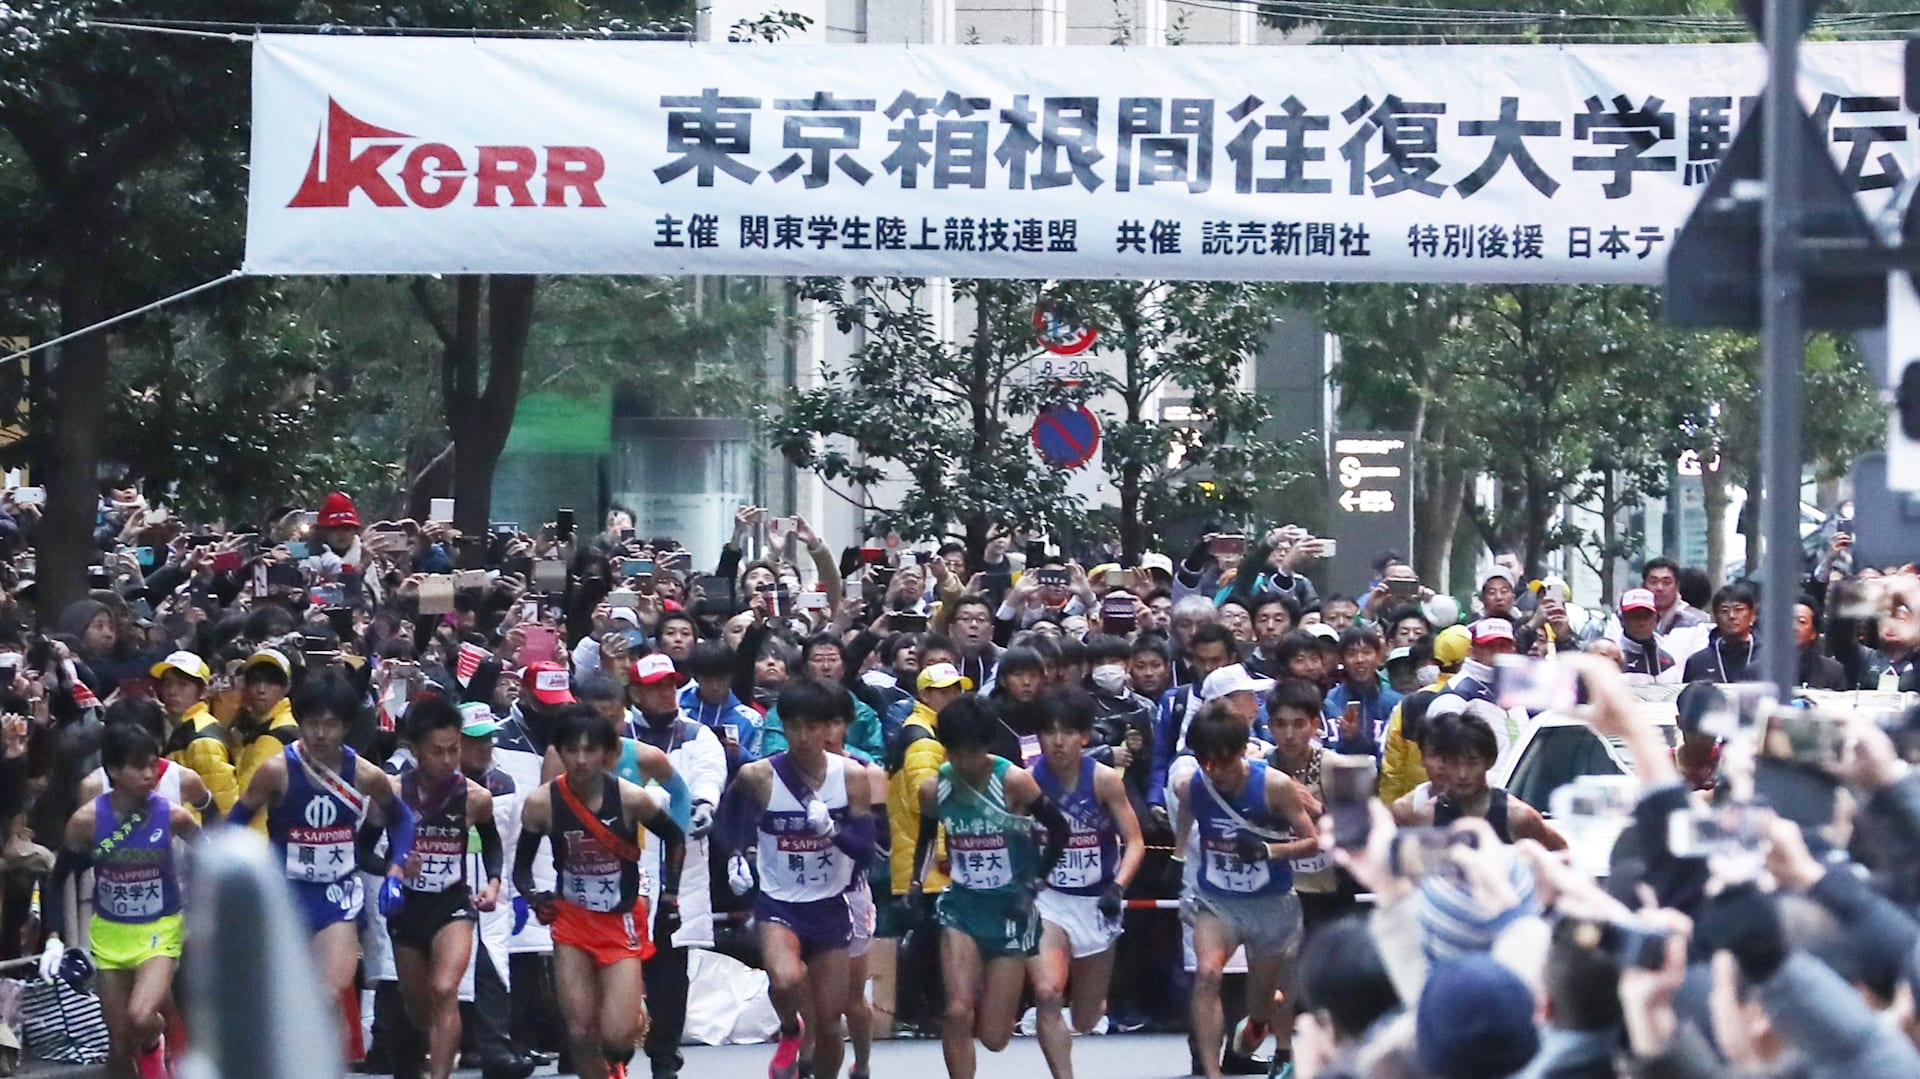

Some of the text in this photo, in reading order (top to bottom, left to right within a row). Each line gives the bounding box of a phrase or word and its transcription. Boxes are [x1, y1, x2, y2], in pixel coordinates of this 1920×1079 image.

[654, 213, 1682, 260] 主催 関東学生陸上競技連盟 共催 読売新聞社 特別後援 日本テ
[1044, 361, 1088, 376] 8-20
[304, 829, 352, 842] SAPPORO
[111, 867, 160, 881] SAPPORO
[796, 873, 829, 886] 4-1
[964, 873, 1001, 887] 2-12
[1225, 876, 1252, 890] 1-1
[111, 902, 147, 914] 10-1
